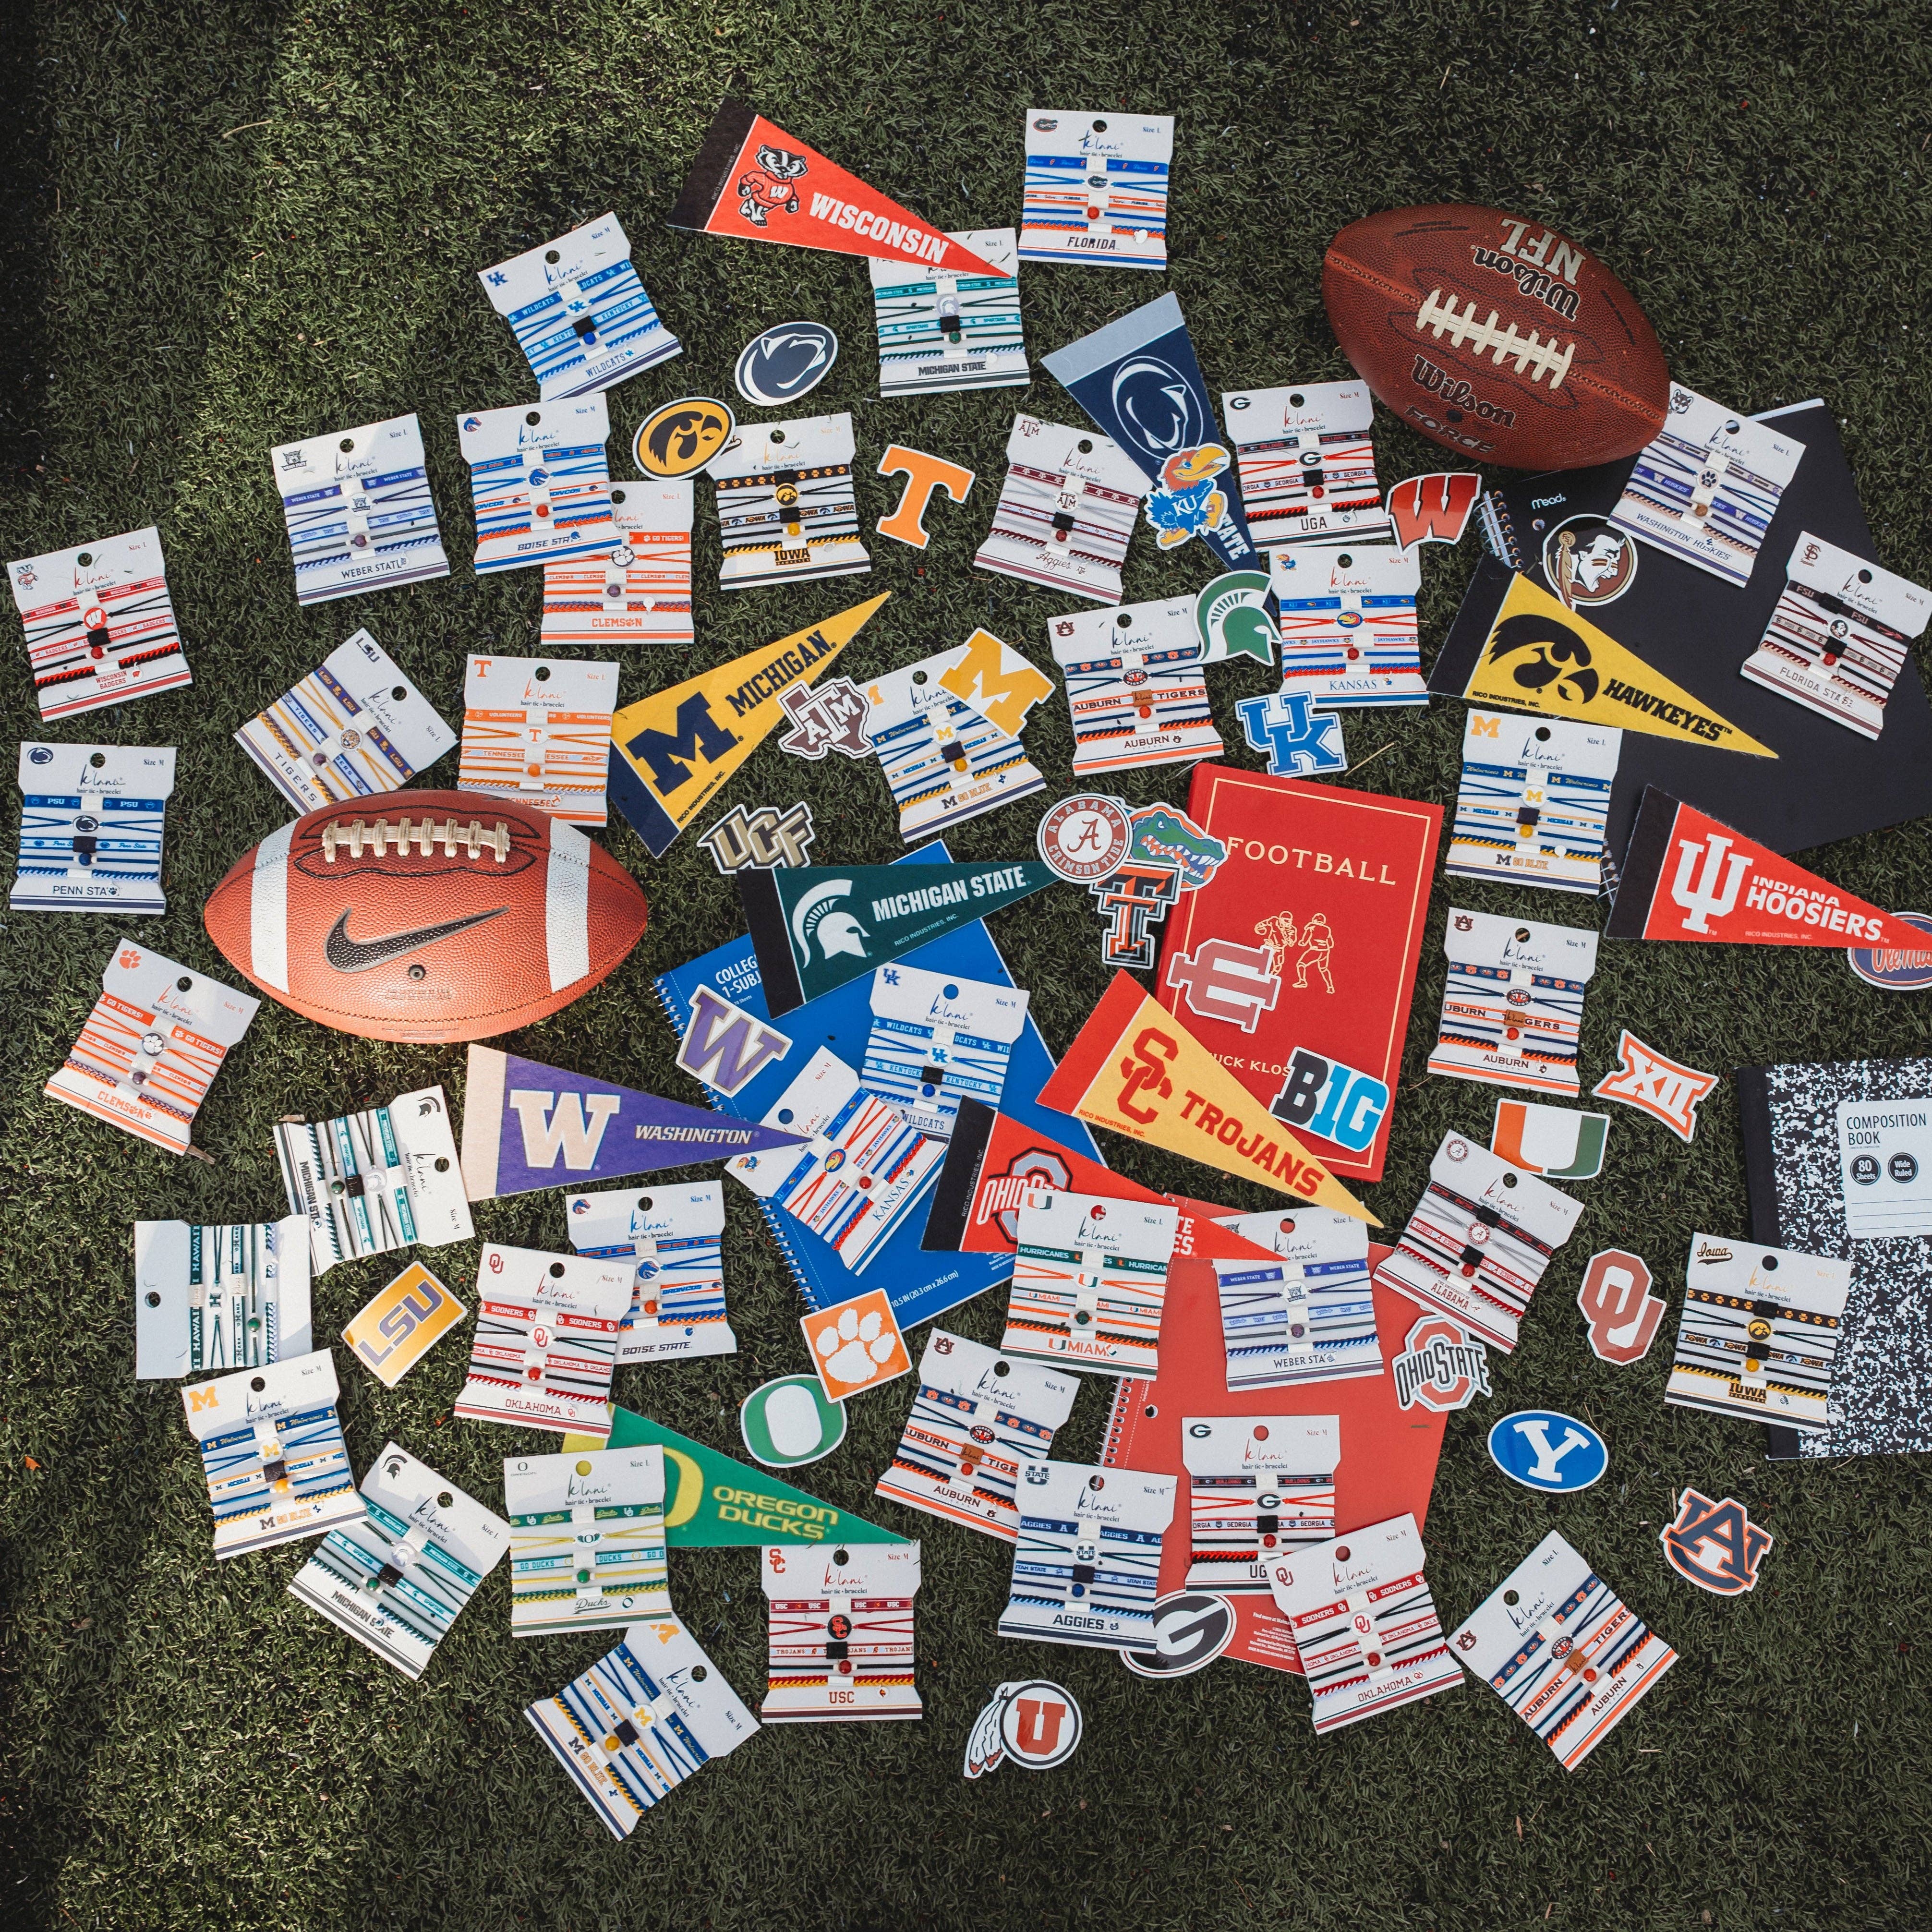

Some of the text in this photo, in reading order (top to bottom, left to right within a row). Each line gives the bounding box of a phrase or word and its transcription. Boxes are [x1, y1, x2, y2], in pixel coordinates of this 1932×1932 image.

[809, 192, 949, 264] WISCONSIN
[1067, 237, 1116, 250] FLORIDA
[1500, 217, 1586, 286] NFL
[1471, 245, 1581, 322] Wilson
[602, 302, 634, 320] KENTUCKY
[585, 353, 626, 377] WILDCATS
[918, 362, 986, 376] MICHIGAN STATE
[1411, 354, 1516, 429] Wilson
[1404, 405, 1497, 454] FORCE
[880, 447, 971, 546] T
[1663, 479, 1690, 493] HUSKIES
[1172, 495, 1196, 516] KU
[1390, 475, 1478, 546] W
[1301, 517, 1327, 531] UGA
[1215, 513, 1249, 559] TATE
[1636, 513, 1731, 560] WASHINGTON HUSKIES
[774, 549, 810, 561] IOWA
[1036, 552, 1072, 570] Aggies
[341, 567, 374, 579] WEBER
[1796, 585, 1814, 598] FSU
[355, 637, 380, 664] LSU
[96, 671, 127, 684] WISCONSIN
[474, 660, 492, 677] T
[725, 629, 831, 717] MICHIGAN
[100, 678, 127, 689] BADGERS
[938, 631, 1053, 737] M
[1157, 689, 1206, 700] TIGERS
[1329, 679, 1377, 690] KANSAS
[1489, 694, 1526, 707] INDUSTRIES,
[1603, 678, 1724, 742] HAWKEYES
[1238, 691, 1342, 775] UK
[1471, 715, 1501, 738] M
[625, 691, 739, 797] M
[1124, 735, 1169, 749] AUBURN
[274, 752, 317, 802] TIGERS
[677, 770, 726, 823] RICO INDUSTRIES, INC.
[1047, 799, 1123, 834] ALABAMA
[710, 806, 809, 867] UCF
[1067, 818, 1101, 853] A
[1049, 838, 1124, 875] CRIMSON TIDE
[1227, 836, 1396, 885] FOOTBALL
[1496, 853, 1511, 866] M
[1525, 860, 1549, 869] BLUE
[872, 865, 1027, 922] MICHIGAN STATE
[1752, 875, 1840, 907] INDIANA
[1745, 886, 1883, 942] HOOSIERS
[894, 914, 959, 946] RICO INDUSTRIES, INC.
[715, 954, 758, 985] COLLEG
[722, 971, 761, 998] 1-SUBJ
[739, 995, 752, 1003] Sheets
[683, 989, 790, 1091] W
[886, 1022, 922, 1035] WILDCATS
[184, 1035, 223, 1055] GO TIGERS!
[1483, 1054, 1529, 1068] AUBURN
[946, 1076, 982, 1088] KENTUCKY
[509, 1089, 620, 1170] W
[1078, 1109, 1146, 1137] RICO INDUSTRIES, INC.
[1847, 1113, 1926, 1130] COMPOSITION
[636, 1125, 752, 1144] WASHINGTON
[1179, 1089, 1325, 1196] TROJANS
[1493, 1102, 1606, 1177] U
[1848, 1131, 1880, 1145] BOOK
[1859, 1160, 1872, 1172] 80
[300, 1160, 317, 1205] MICHIGAN
[872, 1178, 909, 1221] KANSAS
[1027, 1193, 1053, 1210] U
[489, 1253, 504, 1274] OU
[1020, 1247, 1069, 1259] HURRICANES
[662, 1284, 702, 1295] BRONCOS
[1431, 1283, 1469, 1310] ALABAMA
[491, 1305, 523, 1317] SOONERS
[358, 1280, 444, 1366] LSU
[568, 1317, 602, 1329] SOONERS
[622, 1341, 691, 1356] BOISE STATE
[1048, 1338, 1066, 1350] U
[1395, 1342, 1489, 1407] OHIO STATE
[1729, 1383, 1766, 1399] IOWA
[505, 1399, 561, 1416] OKLAHOMA
[744, 1377, 845, 1464] O
[1513, 1420, 1590, 1483] Y
[1025, 1471, 1050, 1480] STATE
[713, 1486, 839, 1525] OREGON
[933, 1485, 981, 1508] AUBURN
[719, 1506, 824, 1539] DUCKS
[532, 1559, 555, 1568] DUCKS
[599, 1554, 622, 1562] DUCKS
[1276, 1567, 1294, 1587] OU
[1053, 1614, 1104, 1630] AGGIES
[829, 1691, 855, 1704] USC
[1357, 1676, 1413, 1702] OKLAHOMA
[1016, 1699, 1066, 1755] U
